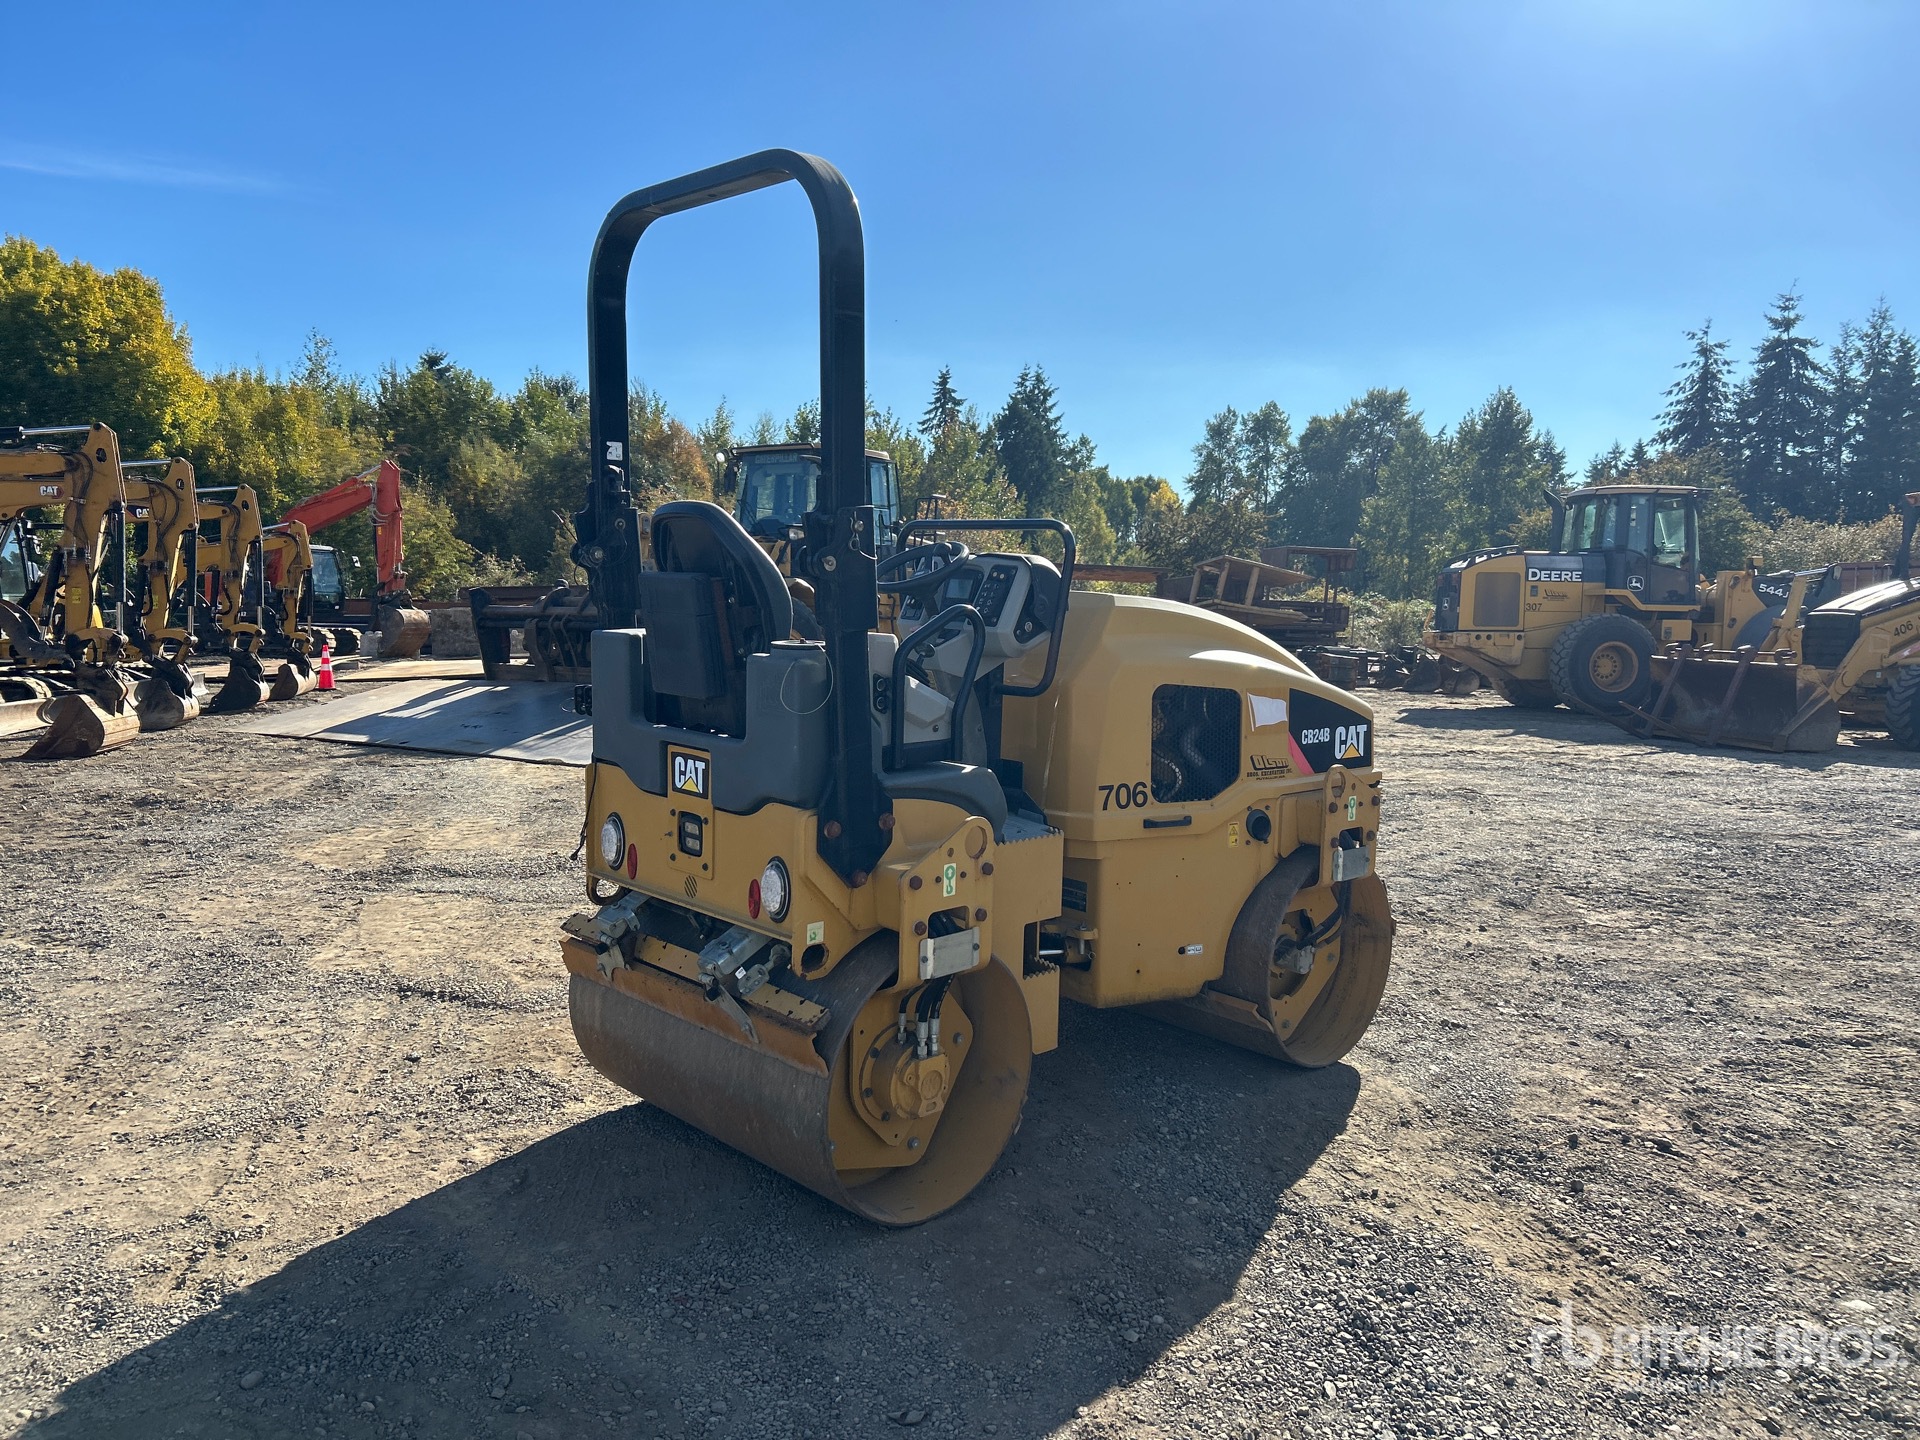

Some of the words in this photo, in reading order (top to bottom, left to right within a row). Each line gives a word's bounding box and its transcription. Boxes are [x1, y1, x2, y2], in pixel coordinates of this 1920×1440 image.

[39, 485, 59, 497] CAT
[1528, 568, 1582, 582] DEERE
[1758, 583, 1789, 598] 544J
[1525, 602, 1543, 611] 307
[1894, 620, 1913, 636] 406
[1301, 727, 1331, 745] CB24B
[1334, 724, 1368, 760] CAT
[674, 756, 706, 794] CAT
[1098, 781, 1148, 811] 706
